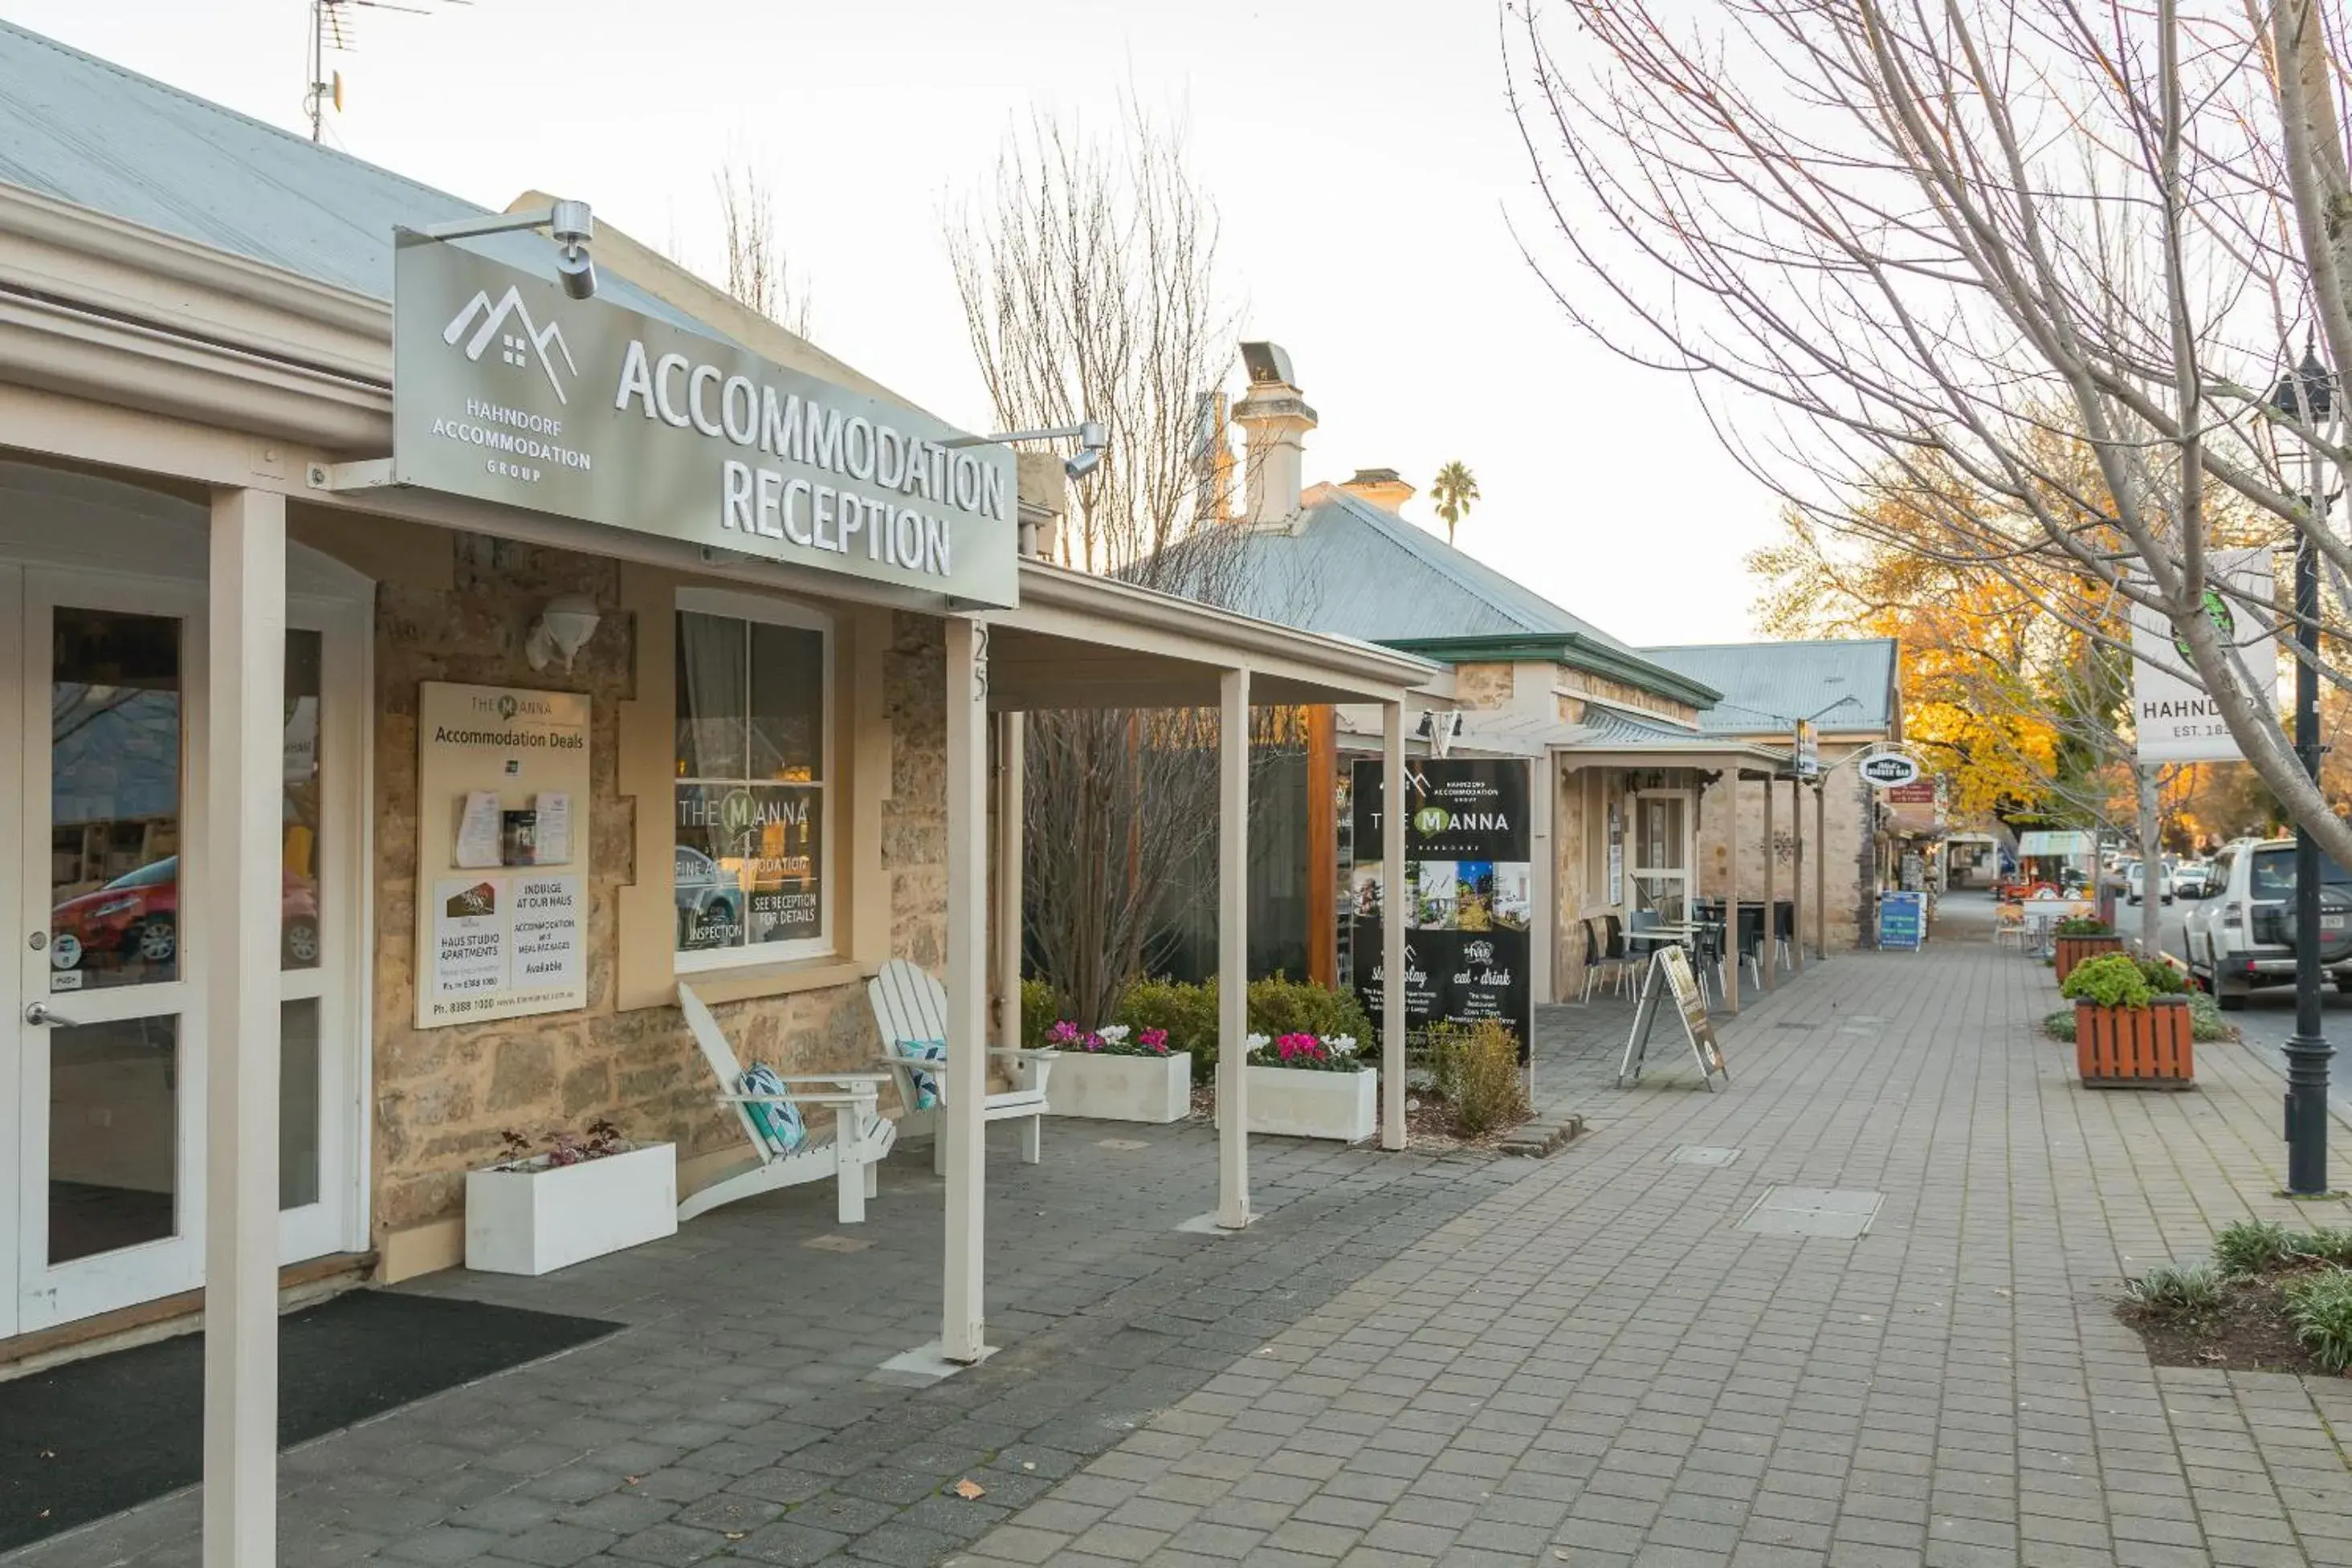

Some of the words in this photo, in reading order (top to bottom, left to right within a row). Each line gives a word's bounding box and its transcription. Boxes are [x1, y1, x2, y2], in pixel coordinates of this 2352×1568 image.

[467, 397, 562, 436] HAHNDORF
[615, 339, 1005, 520] ACCOMMODATION
[432, 417, 591, 470] ACCOMMODATION
[487, 460, 540, 482] GROUP
[723, 459, 951, 576] RECEPTION
[471, 696, 494, 712] THE
[501, 696, 552, 716] MANNA
[435, 726, 546, 747] Accommodation
[549, 732, 584, 749] Deals
[2173, 725, 2202, 738] EST.
[679, 800, 719, 827] THE
[730, 797, 809, 826] MANNA
[1421, 812, 1510, 832] MANNA
[524, 882, 562, 895] INDULGE
[549, 894, 573, 907] HAUS
[755, 896, 771, 911] SEE
[771, 893, 817, 910] RECEPTION
[780, 908, 816, 925] DETAILS
[689, 923, 743, 941] INSPECTION
[441, 946, 499, 960] APARTMENTS
[1480, 967, 1511, 986] drink
